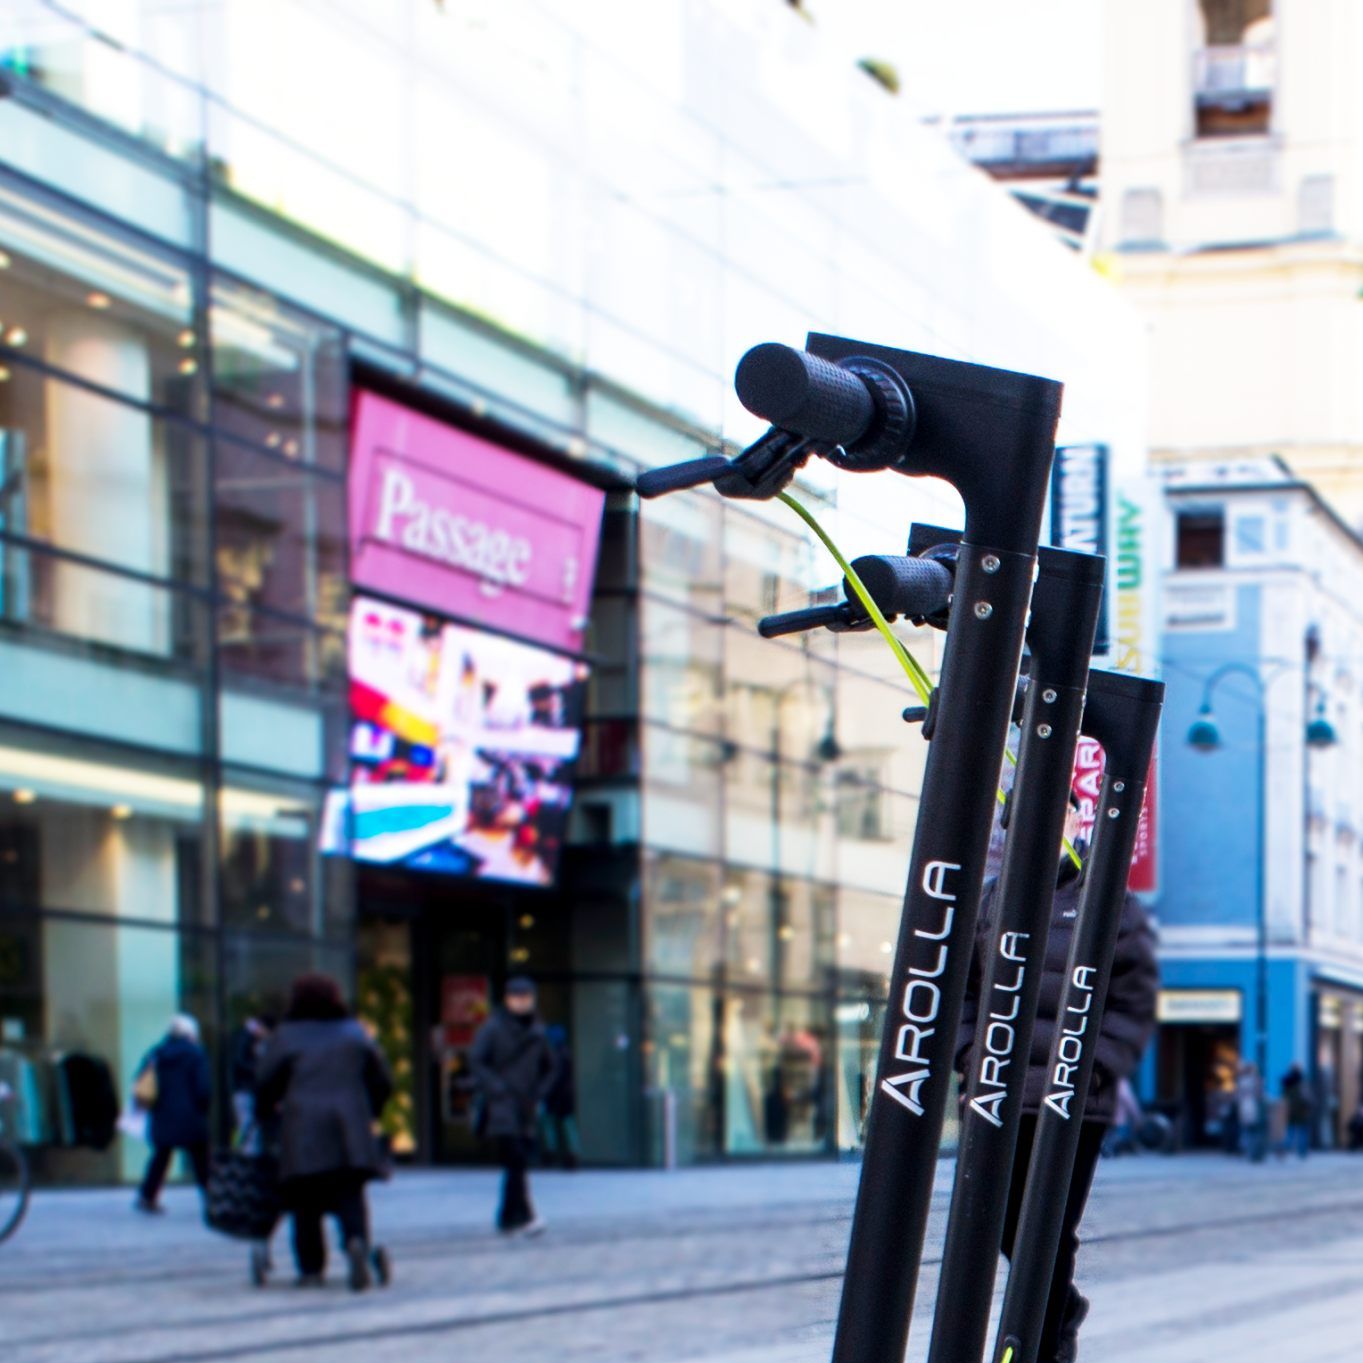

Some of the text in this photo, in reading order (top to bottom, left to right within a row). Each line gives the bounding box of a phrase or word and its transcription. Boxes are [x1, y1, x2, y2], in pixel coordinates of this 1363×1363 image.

[375, 467, 531, 597] Passage
[1060, 448, 1098, 554] ATURN
[881, 860, 961, 1117] AROLLA
[969, 931, 1031, 1127] AROLLA
[1044, 965, 1097, 1120] AROLLA
